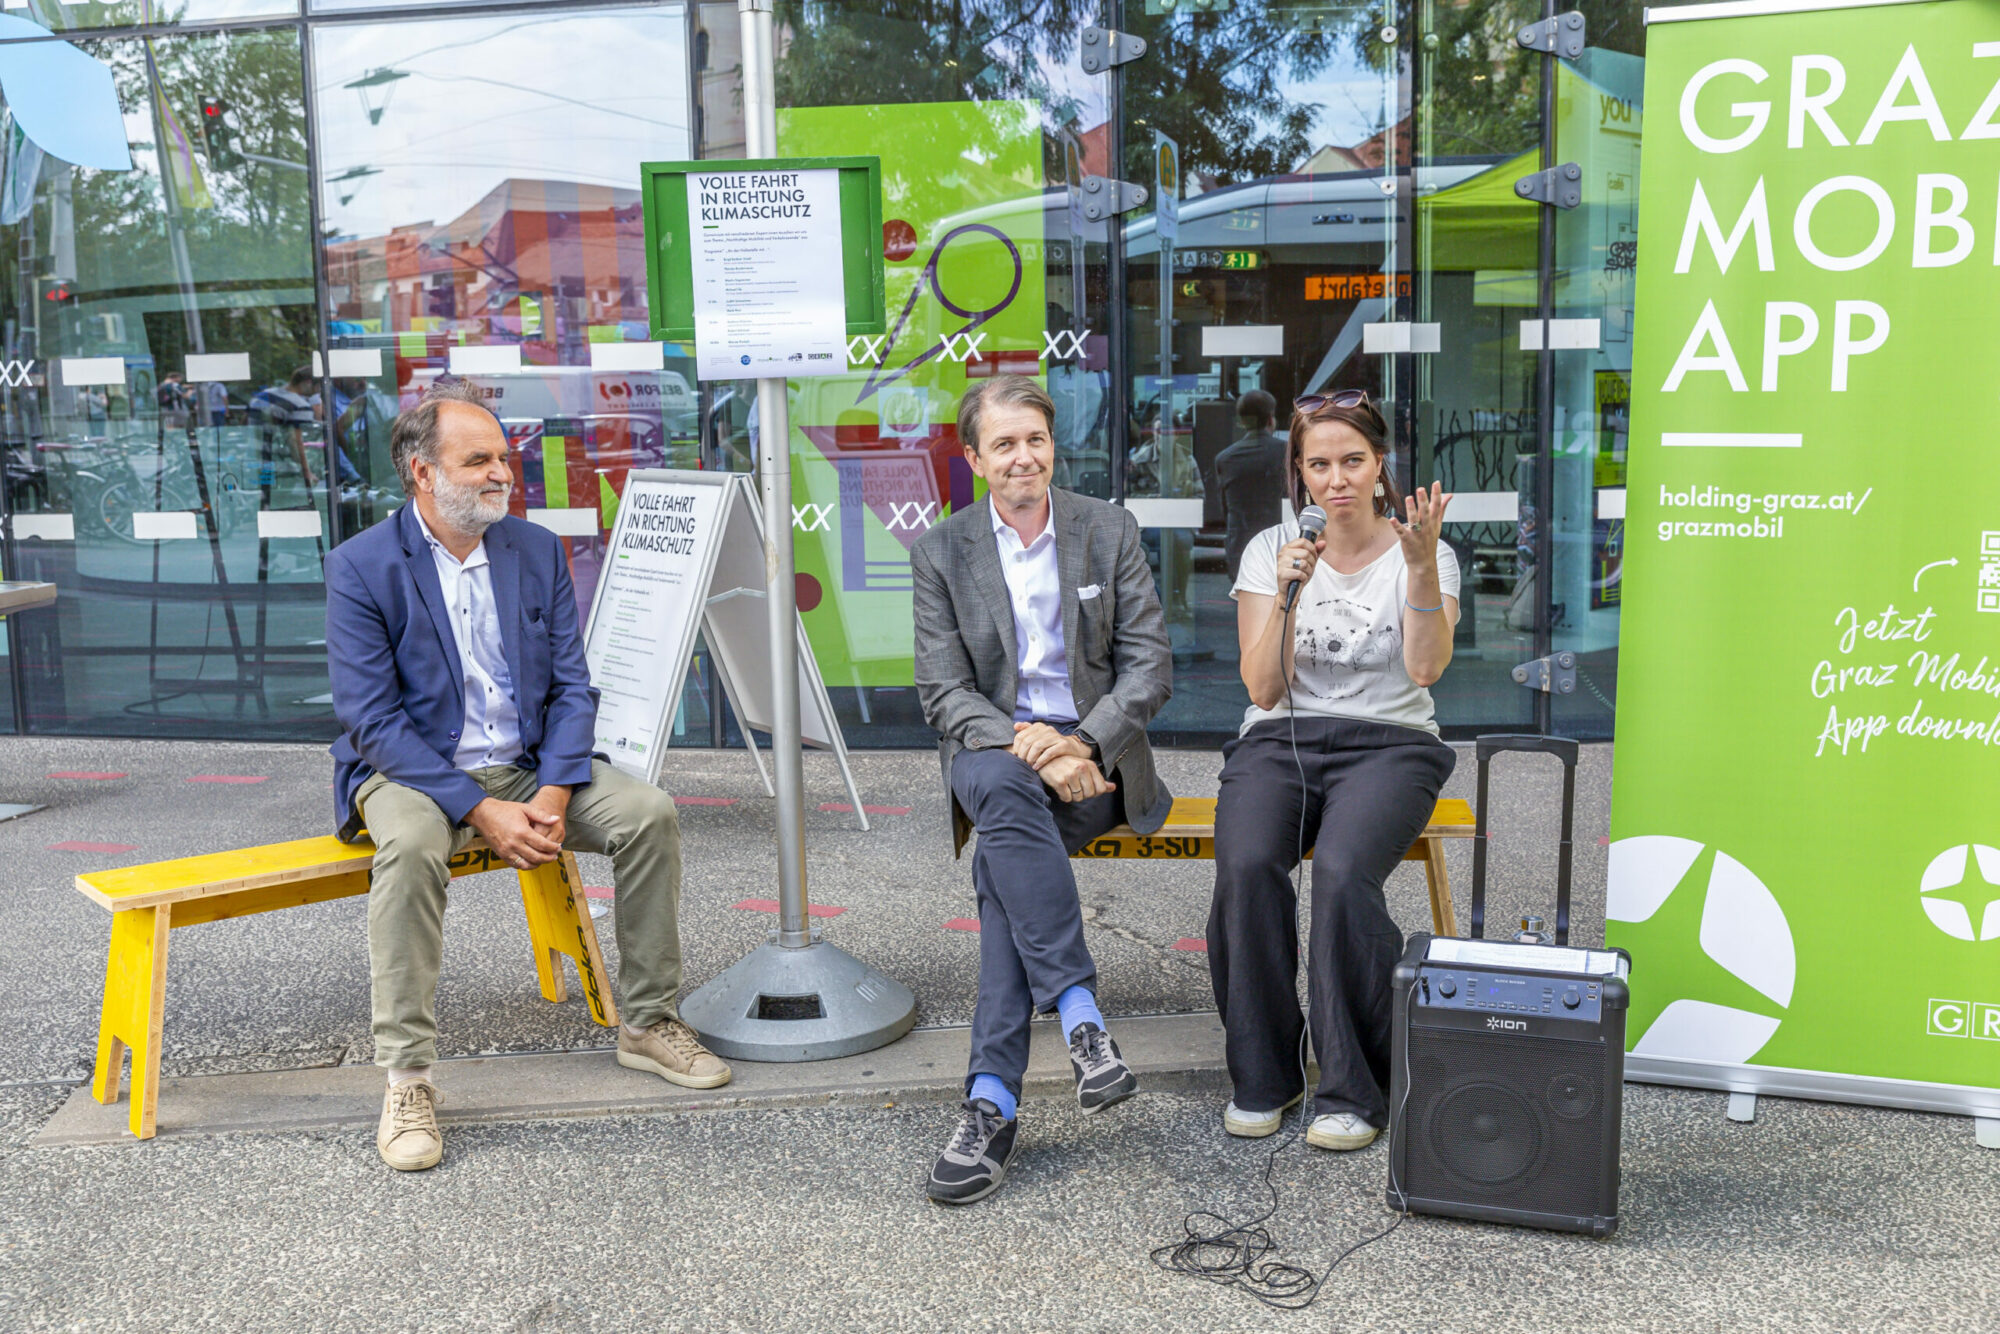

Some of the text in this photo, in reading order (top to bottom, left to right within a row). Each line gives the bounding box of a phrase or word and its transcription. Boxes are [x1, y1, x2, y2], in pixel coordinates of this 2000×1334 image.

[699, 174, 798, 190] VOLLE FAHRT
[700, 189, 805, 205] IN RICHTUNG
[702, 204, 812, 221] KLIMASCHUTZ
[1660, 297, 1891, 393] APP
[633, 493, 696, 513] VOLLE FAHRT
[1658, 484, 1873, 515] holding-graz.at/
[627, 512, 696, 534] IN RICHTUNG
[1657, 516, 1784, 541] grazmobil
[621, 532, 696, 555] KLIMASCHUTZ
[1834, 605, 1937, 654] Jetzt
[1810, 660, 1898, 698] Graz
[1815, 705, 1890, 757] App
